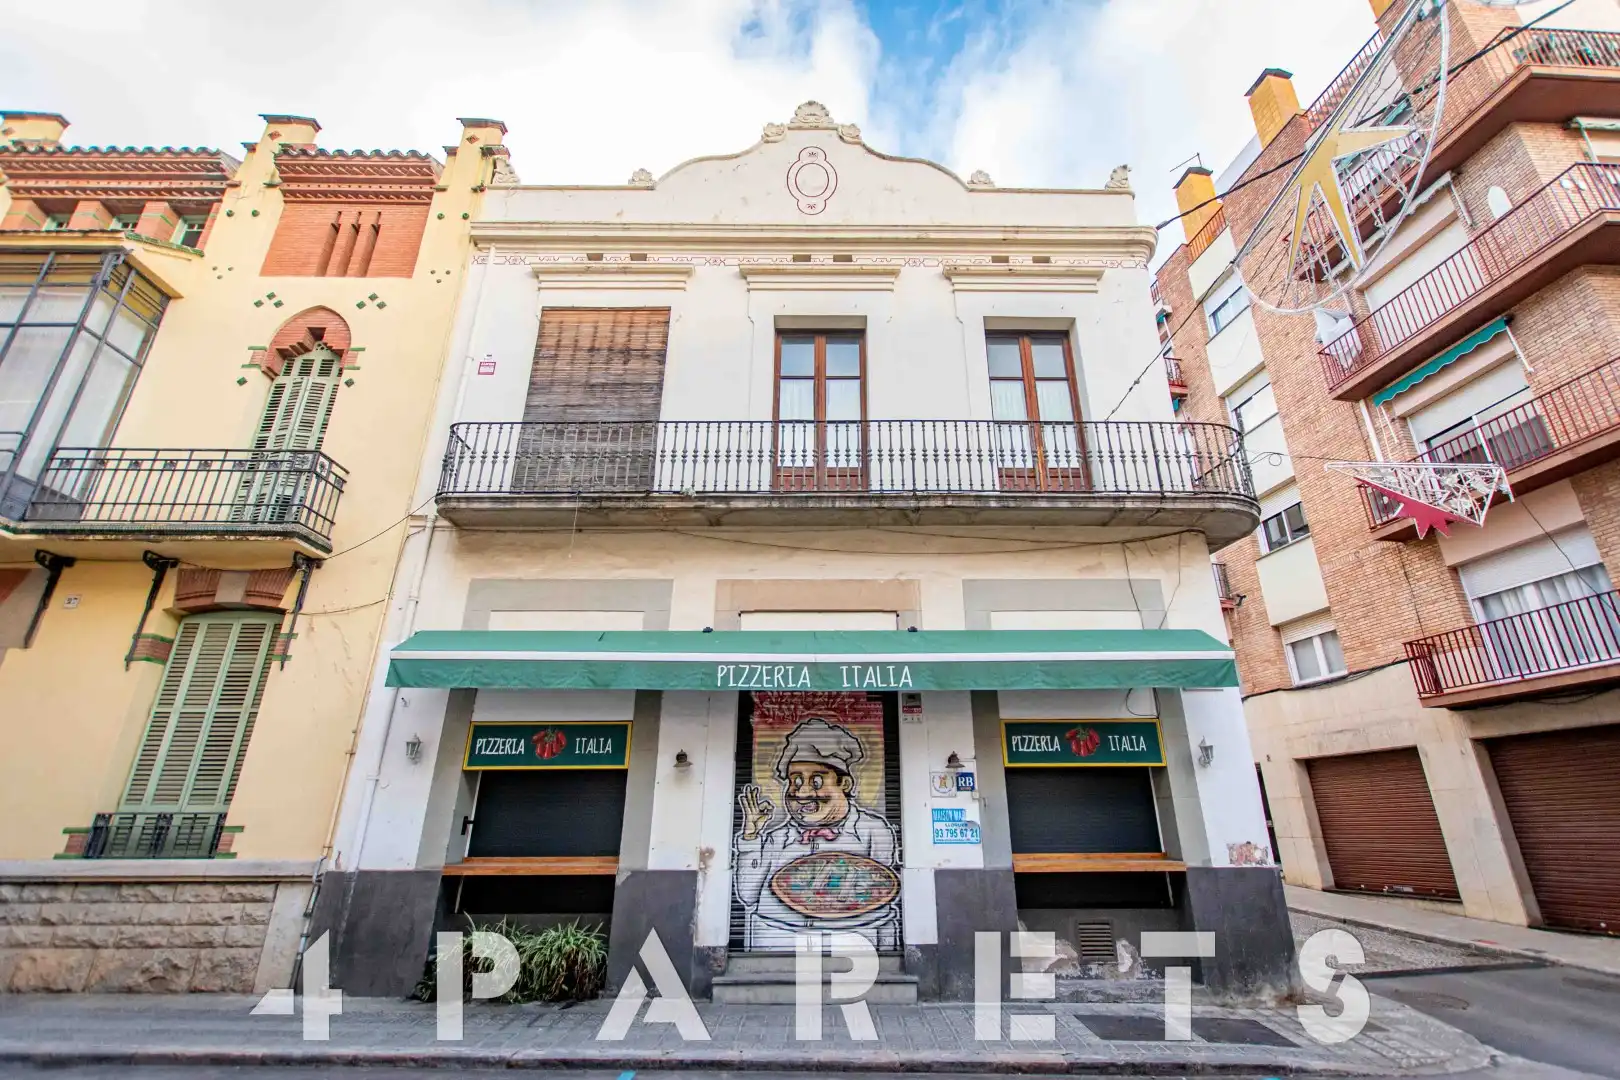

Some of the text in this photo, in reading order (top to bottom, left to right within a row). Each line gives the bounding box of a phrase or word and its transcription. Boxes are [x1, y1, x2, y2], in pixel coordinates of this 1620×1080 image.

[717, 665, 913, 688] PIZZERIA ITALIA
[475, 738, 612, 755] PIZZERIA ITALIA
[1011, 735, 1147, 752] PIZZERIA ITALIA
[958, 776, 974, 787] RB
[935, 828, 979, 838] 93 795 67 21
